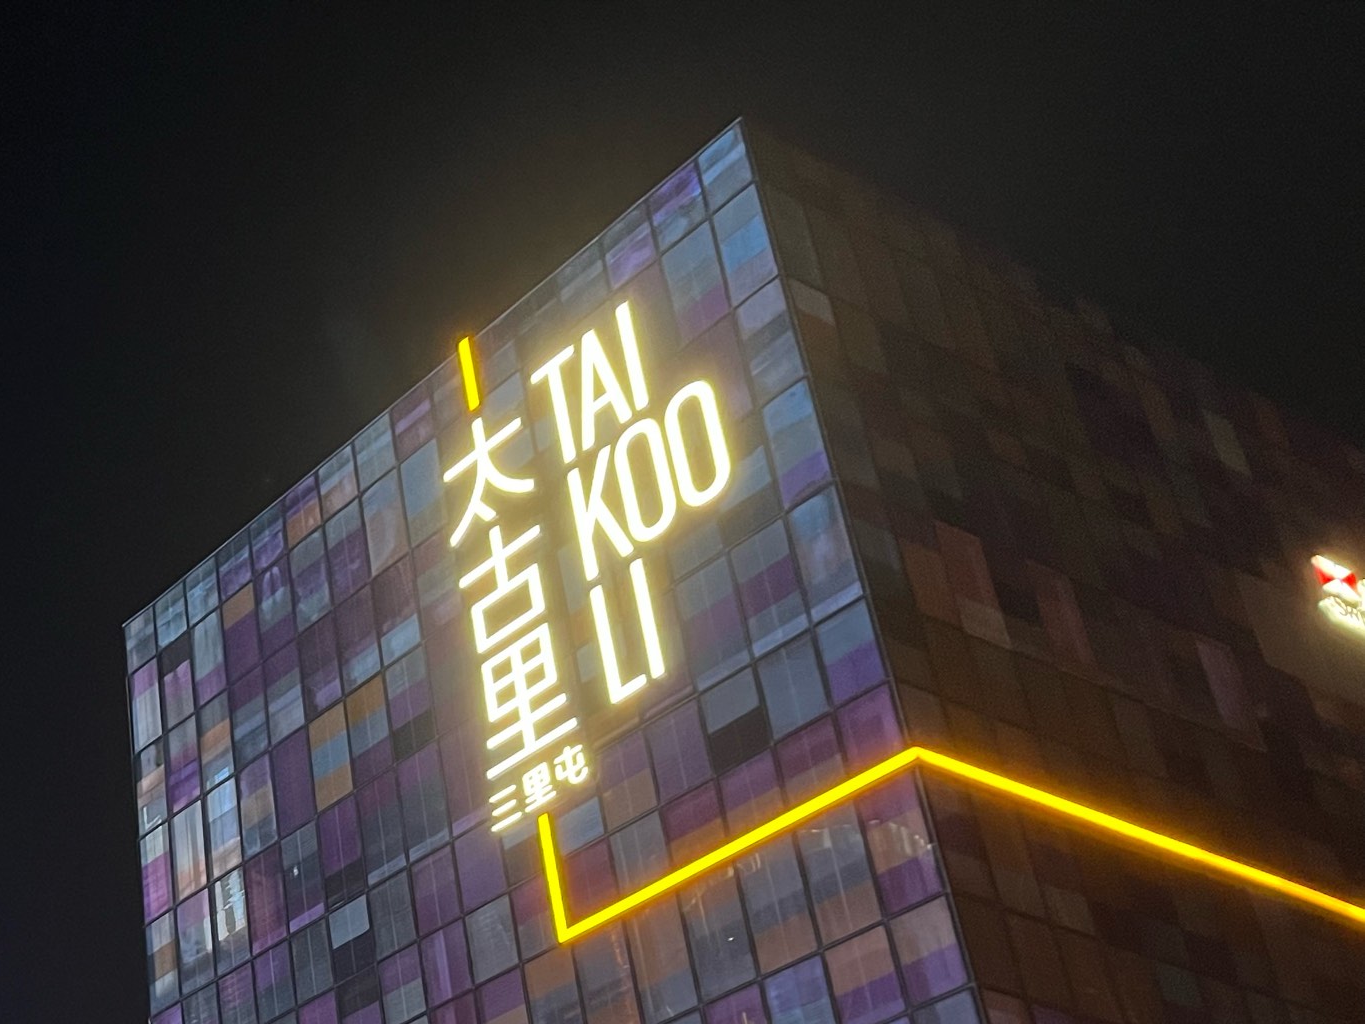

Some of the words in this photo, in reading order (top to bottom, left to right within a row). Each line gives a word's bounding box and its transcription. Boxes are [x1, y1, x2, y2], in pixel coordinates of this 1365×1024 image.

[531, 301, 650, 464] TAI
[568, 380, 731, 581] KOO
[443, 417, 577, 779] 太古里
[590, 558, 666, 704] LI
[489, 745, 589, 833] 三里屯
